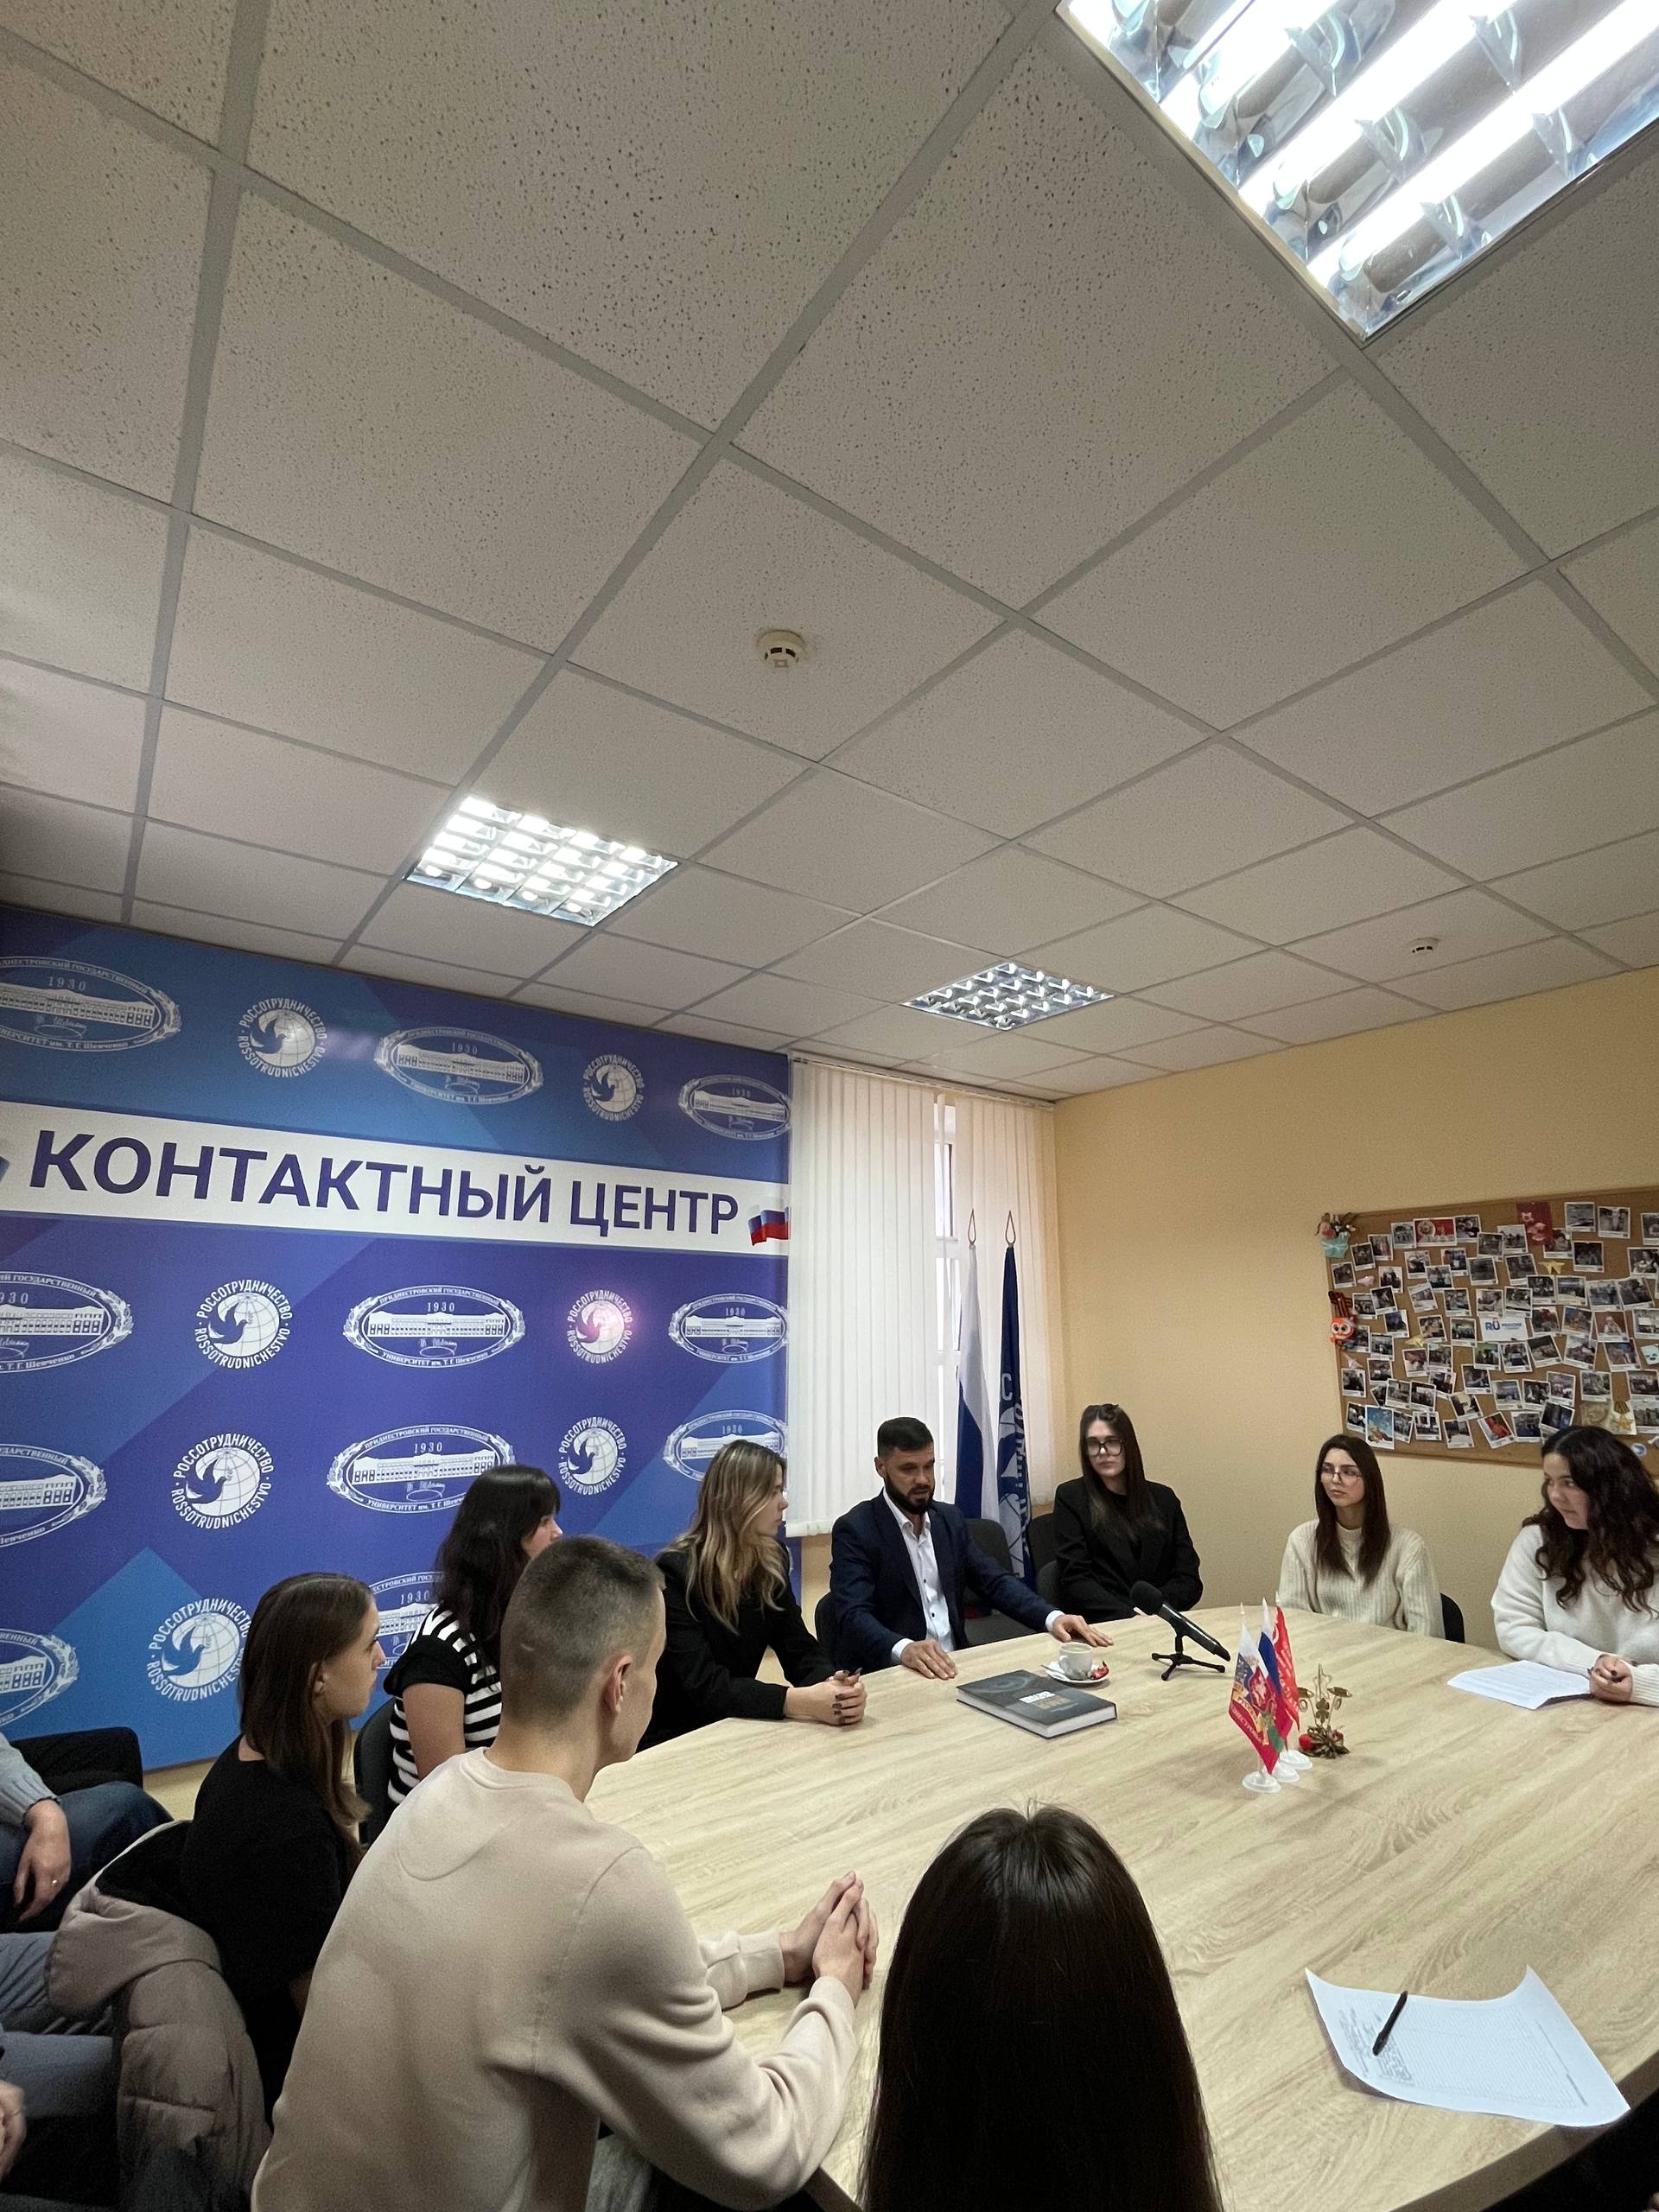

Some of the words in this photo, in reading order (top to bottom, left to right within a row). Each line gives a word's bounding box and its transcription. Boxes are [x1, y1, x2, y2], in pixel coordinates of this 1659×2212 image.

[48, 976, 86, 991] 1930
[238, 998, 327, 1039] РОССОТРУДНИЧЕСТВО
[238, 1035, 326, 1077] ROSSOTRUDNICHESTVO
[29, 1129, 551, 1222] КОНТАКТНЫЙ
[570, 1180, 738, 1236] ЦЕНТР
[196, 1279, 293, 1319] РОССОТРУДНИЧЕСТВО
[427, 1302, 455, 1313] 1930
[567, 1290, 632, 1323] РОССОТРУДНИЧЕСТВО
[194, 1327, 290, 1369] ROSSOTRUDNICHESTVO
[567, 1329, 632, 1363] ROSSOTRUDNICHESTVO
[414, 1442, 442, 1453] 1930
[558, 1416, 626, 1453] РОССОТРУДНИЧЕСТВО
[173, 1433, 274, 1478] РОССОТРУДНИЧЕСТВО
[558, 1457, 626, 1495] ROSSOTRUDNICHESTVO
[171, 1483, 271, 1529] ROSSOTRUDNICHESTVO
[401, 1590, 429, 1605] 1930
